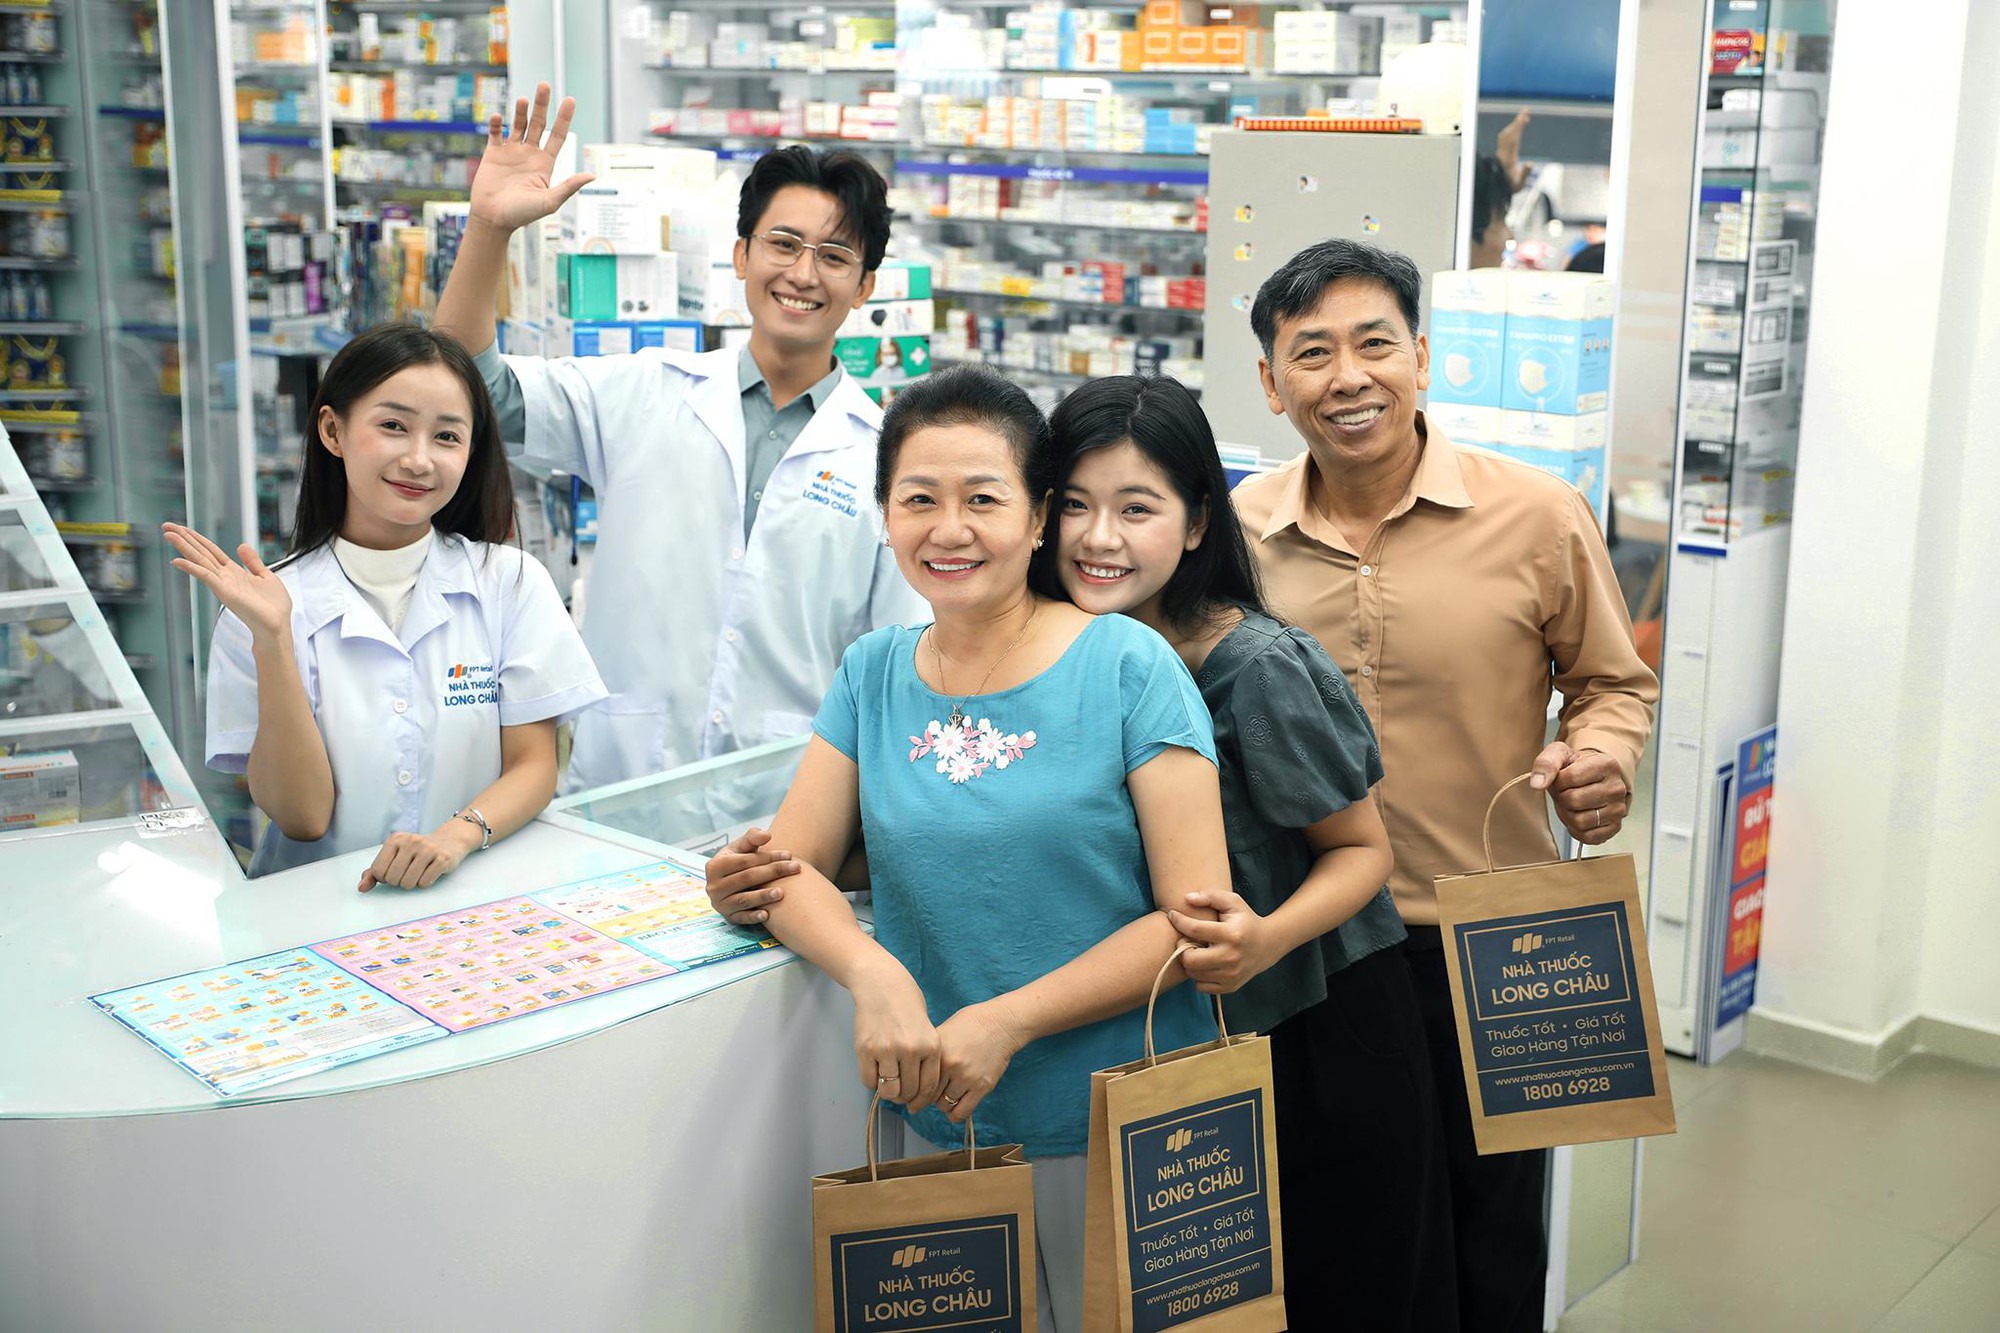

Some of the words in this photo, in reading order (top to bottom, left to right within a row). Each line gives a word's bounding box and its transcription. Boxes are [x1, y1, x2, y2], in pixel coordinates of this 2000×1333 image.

[449, 680, 469, 692] NHÀ
[470, 677, 496, 690] THUỐC
[444, 695, 476, 706] LONG
[1545, 936, 1556, 945] FPT
[1557, 934, 1575, 943] Retail
[1502, 960, 1535, 979] NHÀ
[1538, 951, 1592, 974] THUỐC
[1491, 982, 1549, 1006] LONG
[1554, 971, 1610, 997] CHÂU
[1485, 1023, 1530, 1042] Thuốc
[1532, 1022, 1555, 1036] Tốt
[1574, 1014, 1600, 1029] Giá
[1602, 1011, 1626, 1027] Tốt
[1491, 1045, 1526, 1058] Giao
[1528, 1038, 1568, 1053] Hàng
[1570, 1033, 1599, 1048] Tận
[1602, 1030, 1626, 1043] Nơi
[1495, 1061, 1635, 1086] www.nhathuoclongchau.com.vn
[1523, 1083, 1563, 1101] 1800
[1567, 1077, 1611, 1095] 6928
[1193, 1131, 1204, 1140] FPT
[1204, 1127, 1219, 1137] Retail
[1157, 1159, 1184, 1182] NHÀ
[1186, 1145, 1231, 1173] THUỐC
[1147, 1182, 1195, 1212] LONG
[1198, 1166, 1244, 1195] CHÂU
[1140, 1231, 1177, 1255] Thuốc
[1179, 1224, 1199, 1241] Tốt
[1213, 1214, 1234, 1231] Giá
[1235, 1206, 1255, 1224] Tốt
[928, 1250, 941, 1258] FPT
[941, 1247, 961, 1256] Retail
[1144, 1254, 1174, 1273] Giao
[1176, 1243, 1208, 1259] Hàng
[1210, 1235, 1233, 1252] Tận
[1234, 1226, 1255, 1244] Nơi
[878, 1275, 914, 1295] NHÀ
[918, 1265, 976, 1290] THUỐC
[1145, 1261, 1261, 1305] www.nhathuoclongchau.com.vn
[864, 1298, 927, 1323] LONG
[932, 1286, 992, 1314] CHÂU
[1167, 1294, 1200, 1317] 1800
[1203, 1281, 1239, 1304] 6928
